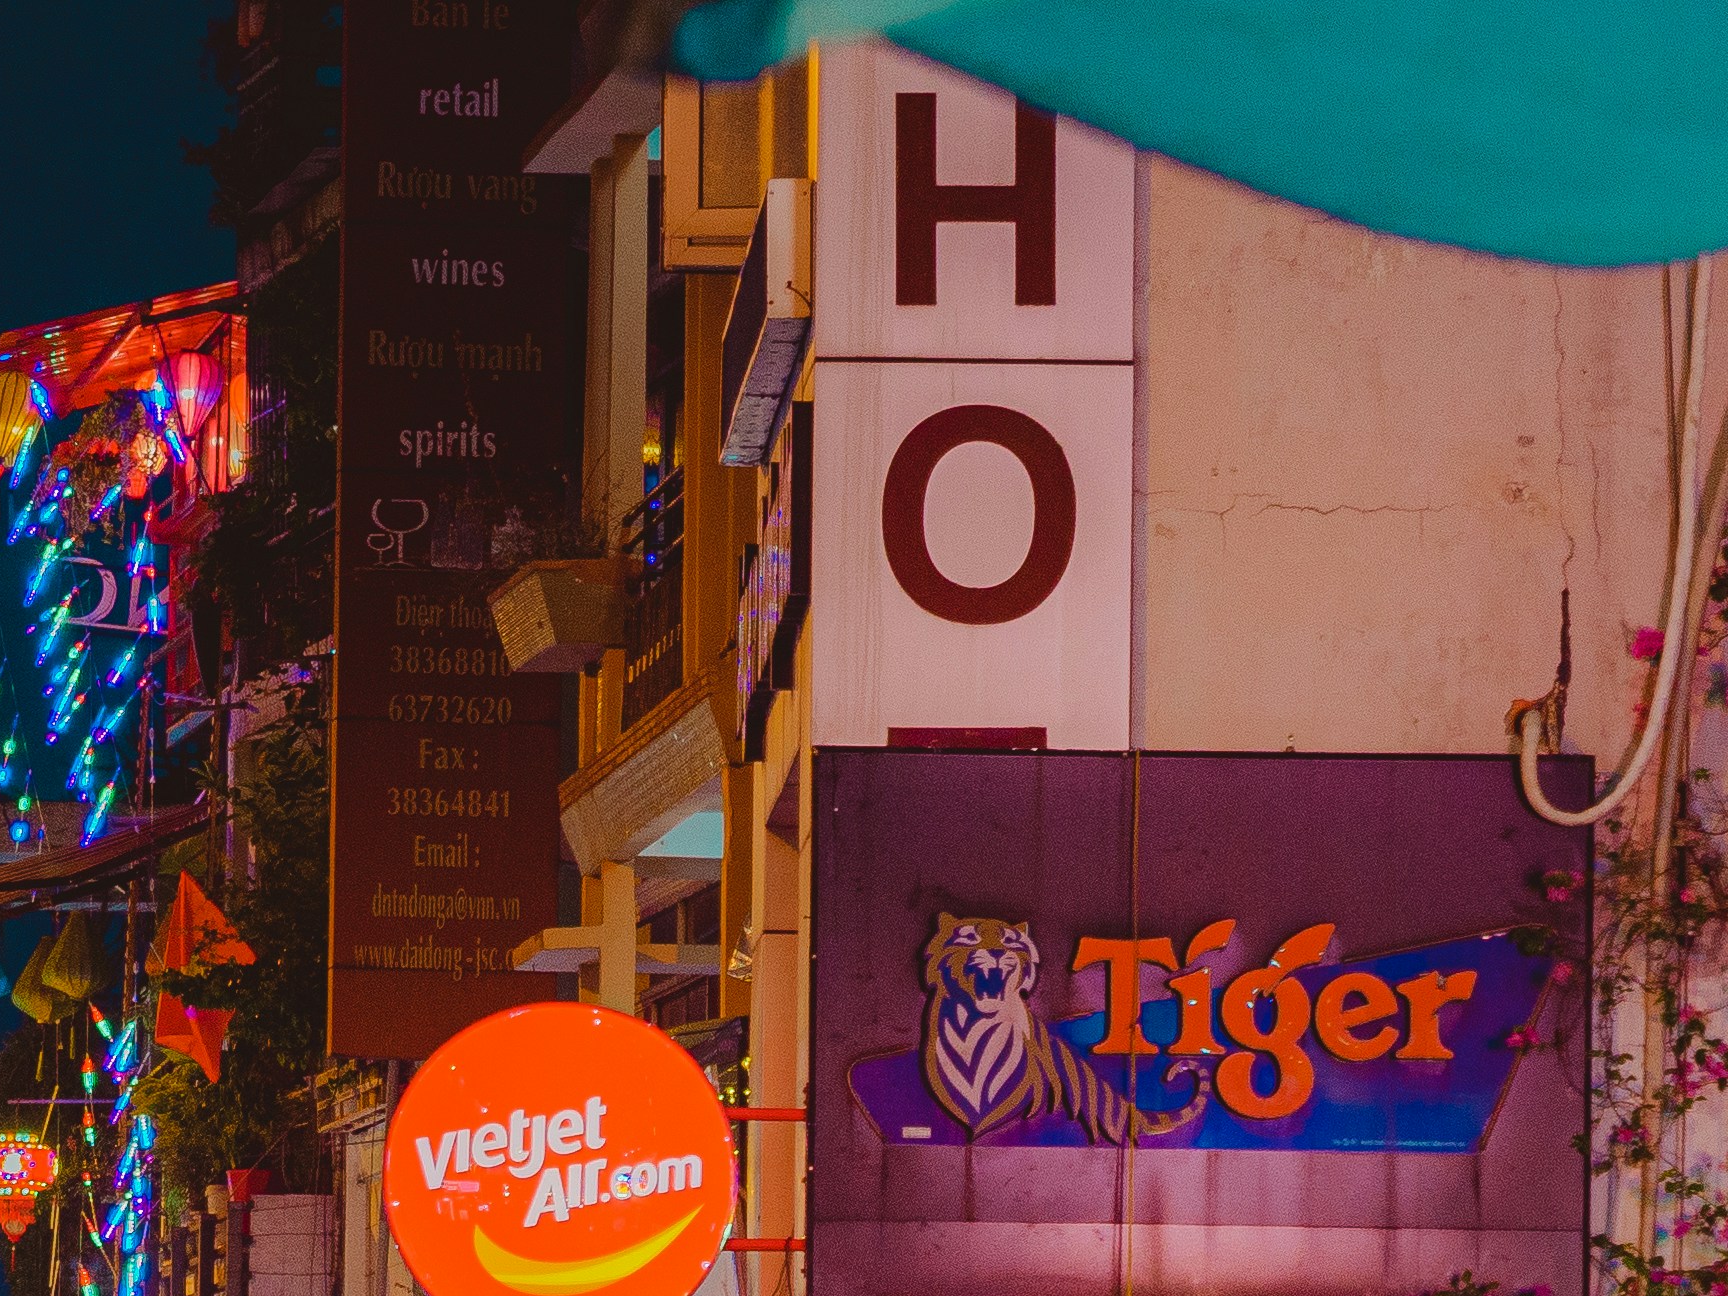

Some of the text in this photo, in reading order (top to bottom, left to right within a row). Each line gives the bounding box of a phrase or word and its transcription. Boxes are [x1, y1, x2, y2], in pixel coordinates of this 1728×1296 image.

[419, 78, 499, 117] retail
[468, 174, 536, 215] vang
[412, 249, 504, 287] wines
[883, 92, 1076, 748] HO
[399, 421, 496, 468] spirits
[449, 593, 494, 637] thoạ
[389, 695, 511, 724] 63732620
[388, 788, 510, 817] 38364841
[1073, 919, 1477, 1120] Tiger
[416, 1096, 607, 1190] Vietjet
